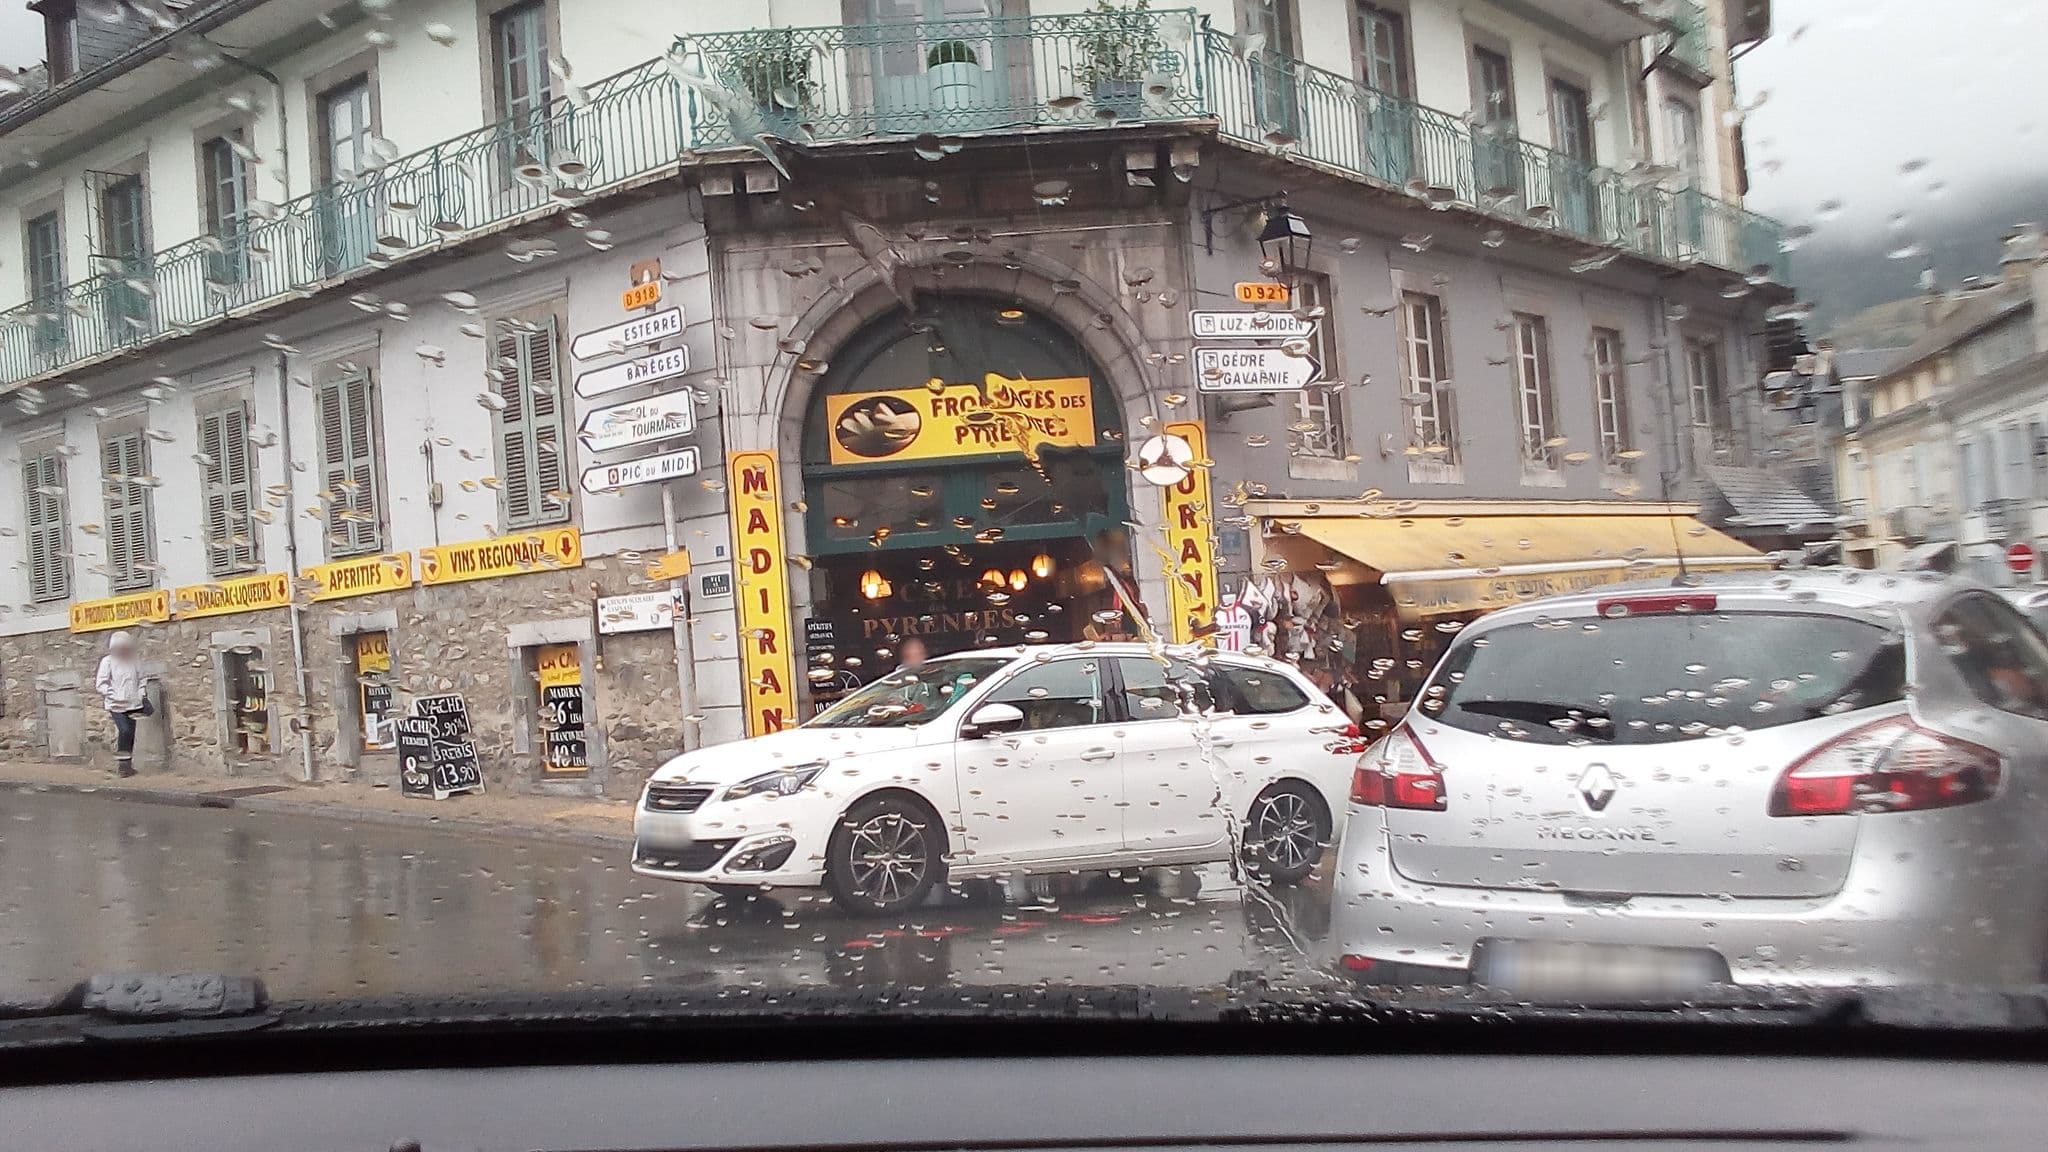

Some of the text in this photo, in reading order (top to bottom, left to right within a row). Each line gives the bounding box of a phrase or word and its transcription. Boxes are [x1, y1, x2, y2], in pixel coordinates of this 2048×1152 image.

[626, 286, 655, 306] D 918
[1243, 287, 1284, 299] D 921
[624, 314, 678, 341] ESTERRE
[1224, 371, 1289, 384] GAVARNIE
[650, 407, 659, 416] DU
[1060, 395, 1086, 409] DES
[622, 456, 690, 481] PIC DU MIDI
[450, 539, 545, 574] VINS REGIONAUX
[329, 563, 382, 592] APERITIFS
[193, 581, 272, 611] ARMAGNAC-LIQUEURS
[742, 468, 783, 733] MADIRAN
[432, 744, 474, 762] BREBIS
